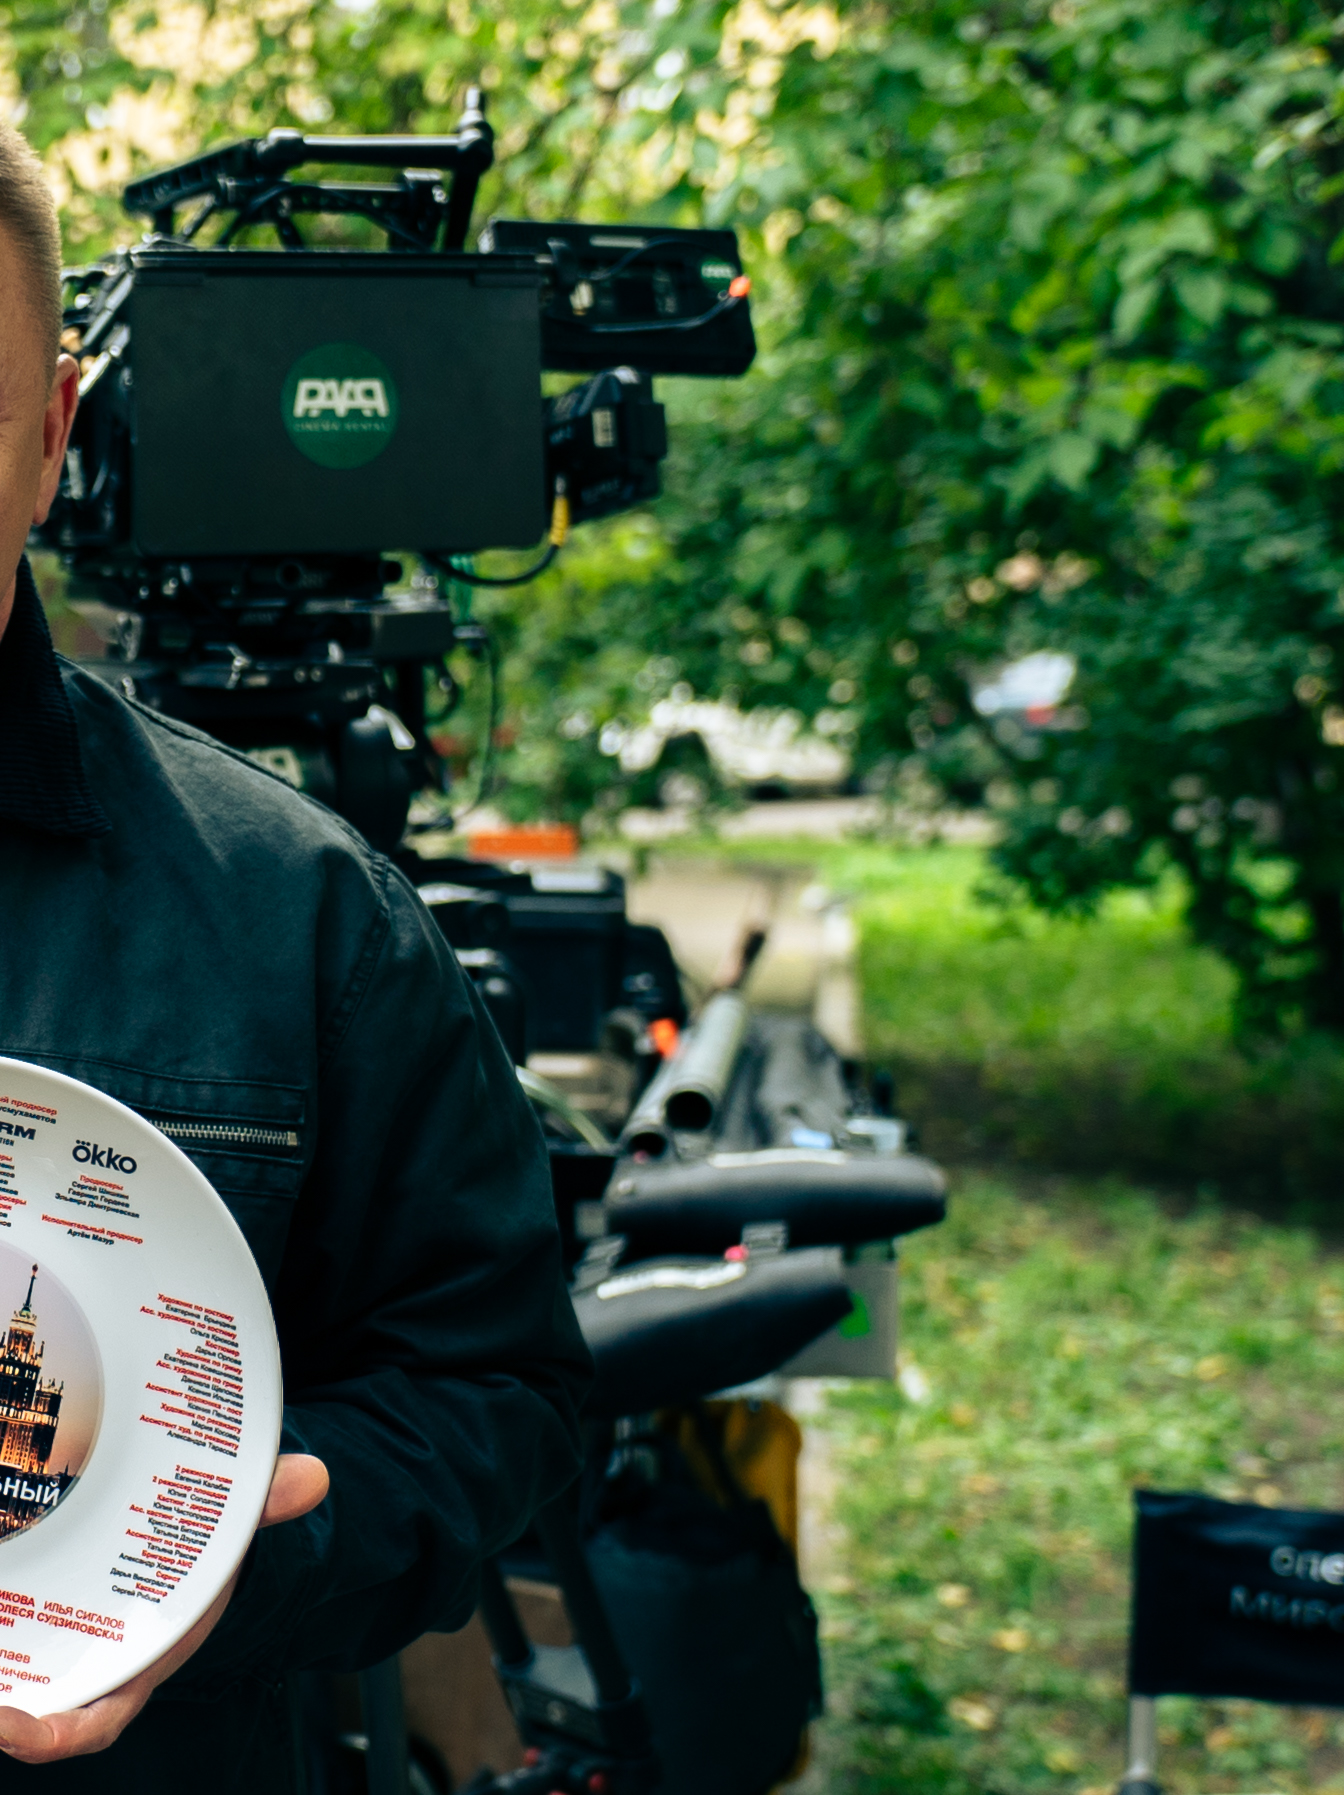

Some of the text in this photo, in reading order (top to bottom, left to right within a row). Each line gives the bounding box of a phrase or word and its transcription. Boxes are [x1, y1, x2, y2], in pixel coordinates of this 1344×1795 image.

[211, 1376, 222, 1384] по
[196, 1414, 207, 1422] по
[43, 1600, 125, 1629] ИЛЬЯ СИГАЛОВ
[36, 1612, 124, 1641] СУДЗИЛОВСКАЯ
